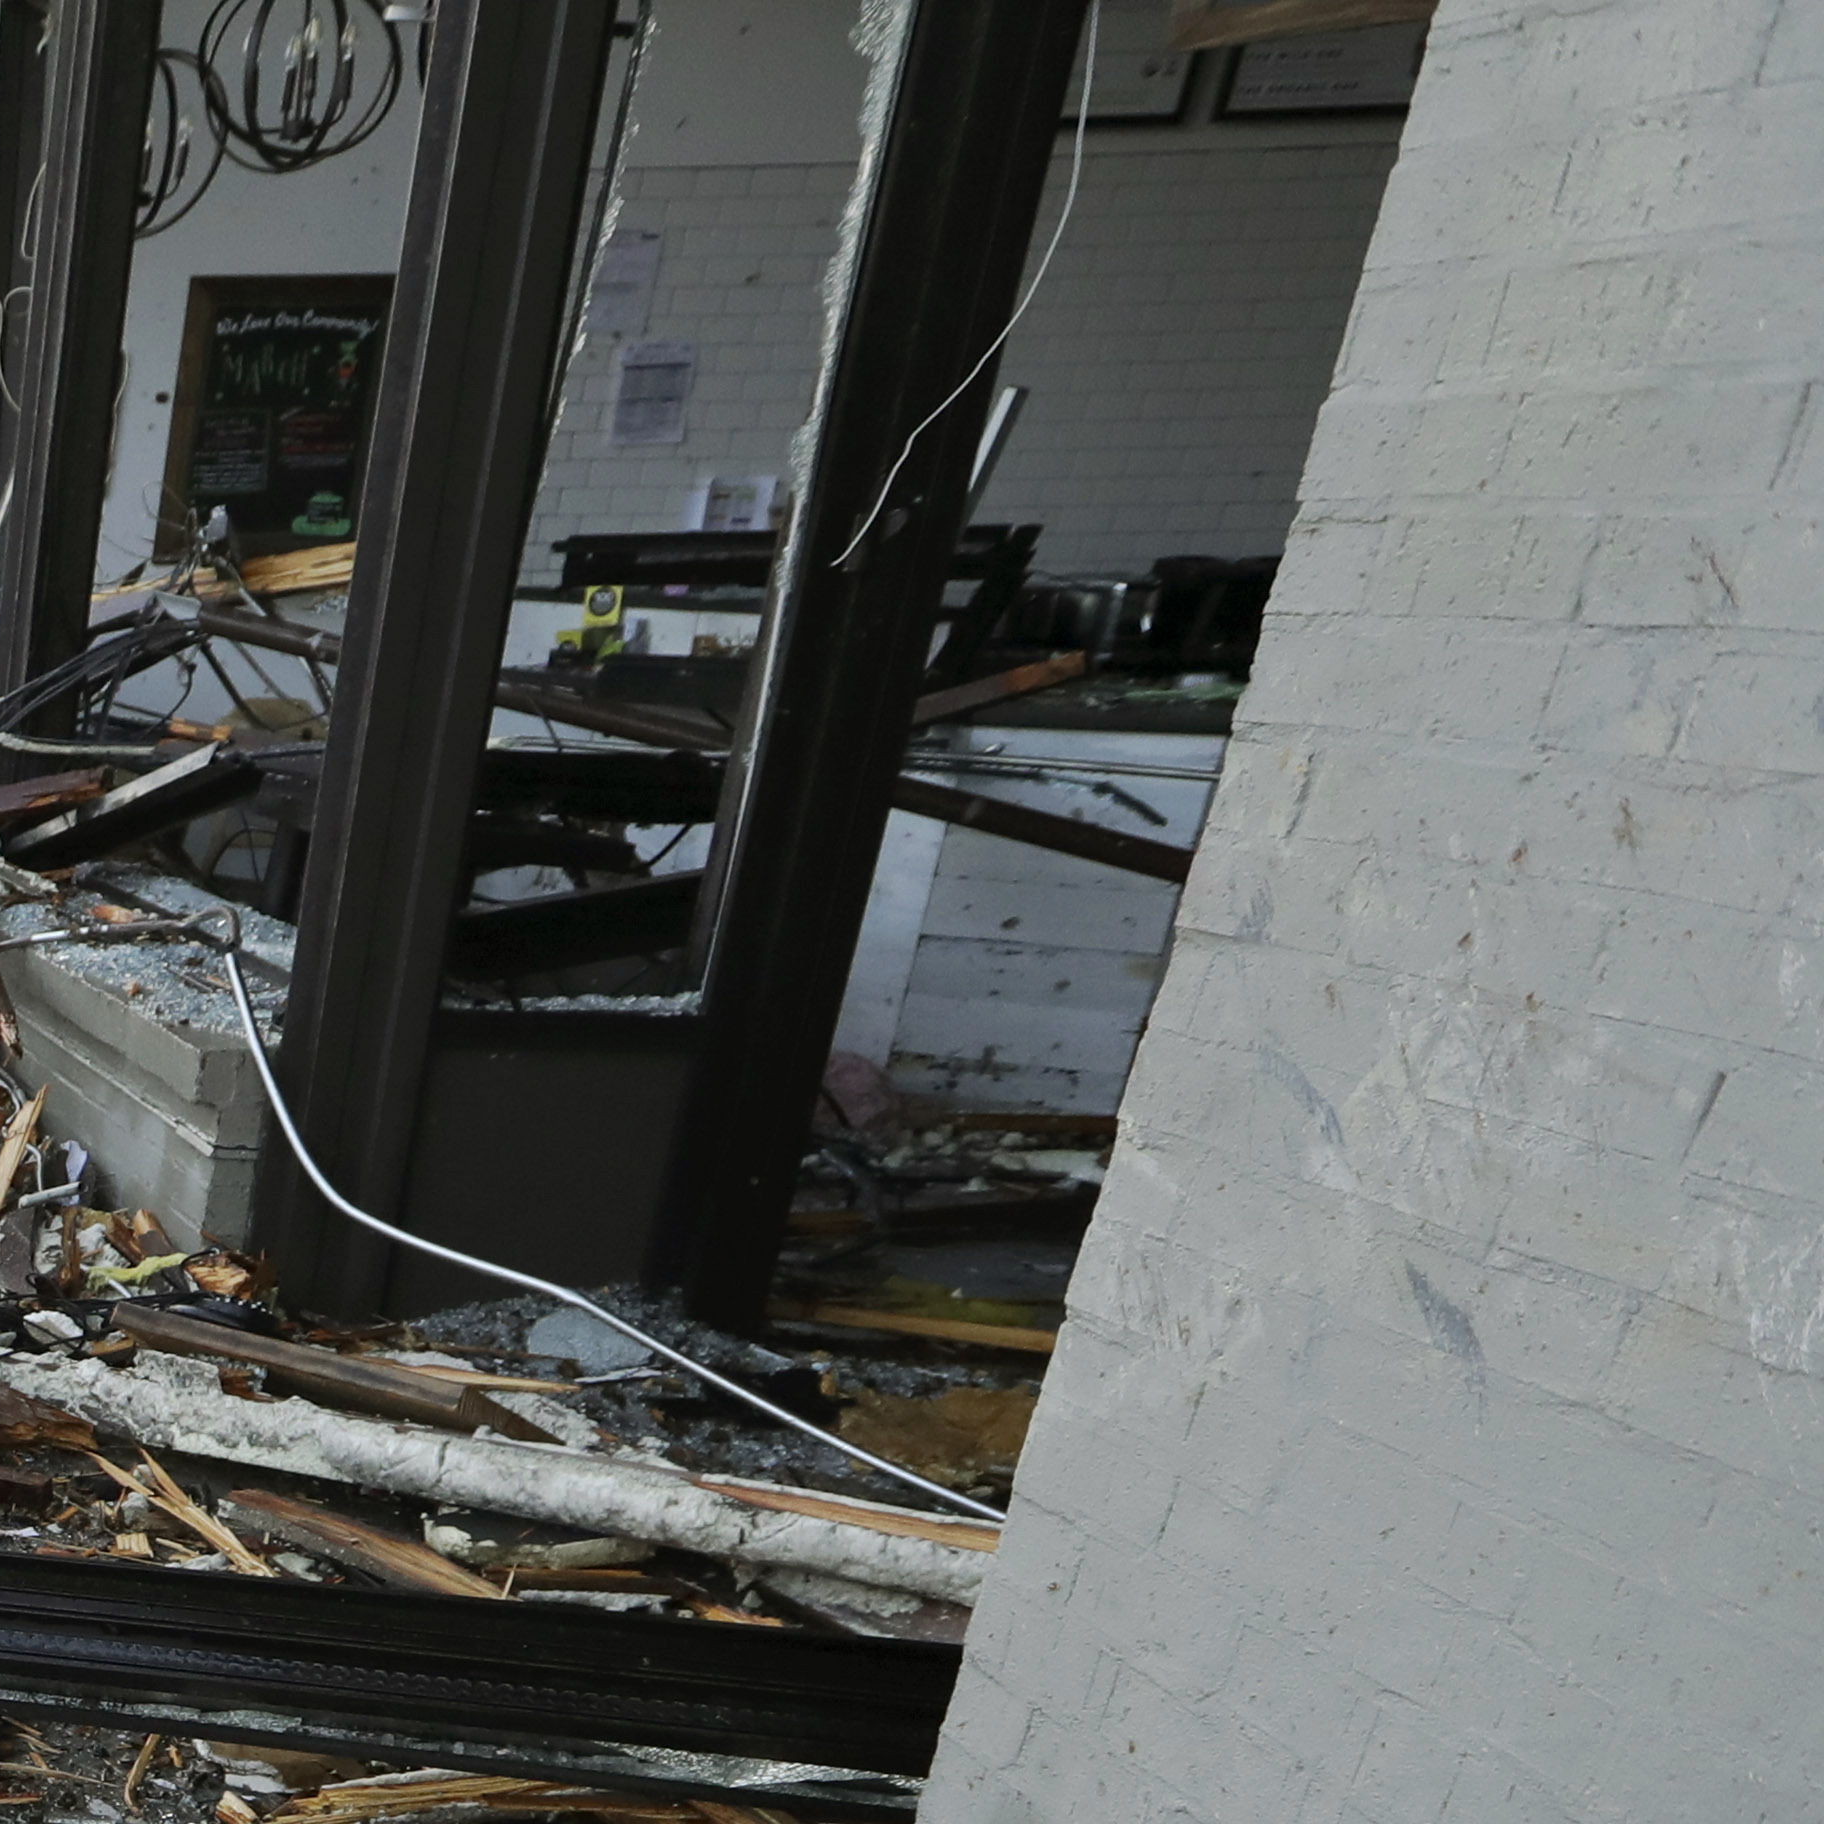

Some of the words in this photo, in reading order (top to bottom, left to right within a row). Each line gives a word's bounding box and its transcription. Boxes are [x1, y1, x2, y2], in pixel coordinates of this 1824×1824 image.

[217, 316, 238, 335] We
[238, 312, 271, 333] Love
[274, 310, 300, 328] Our
